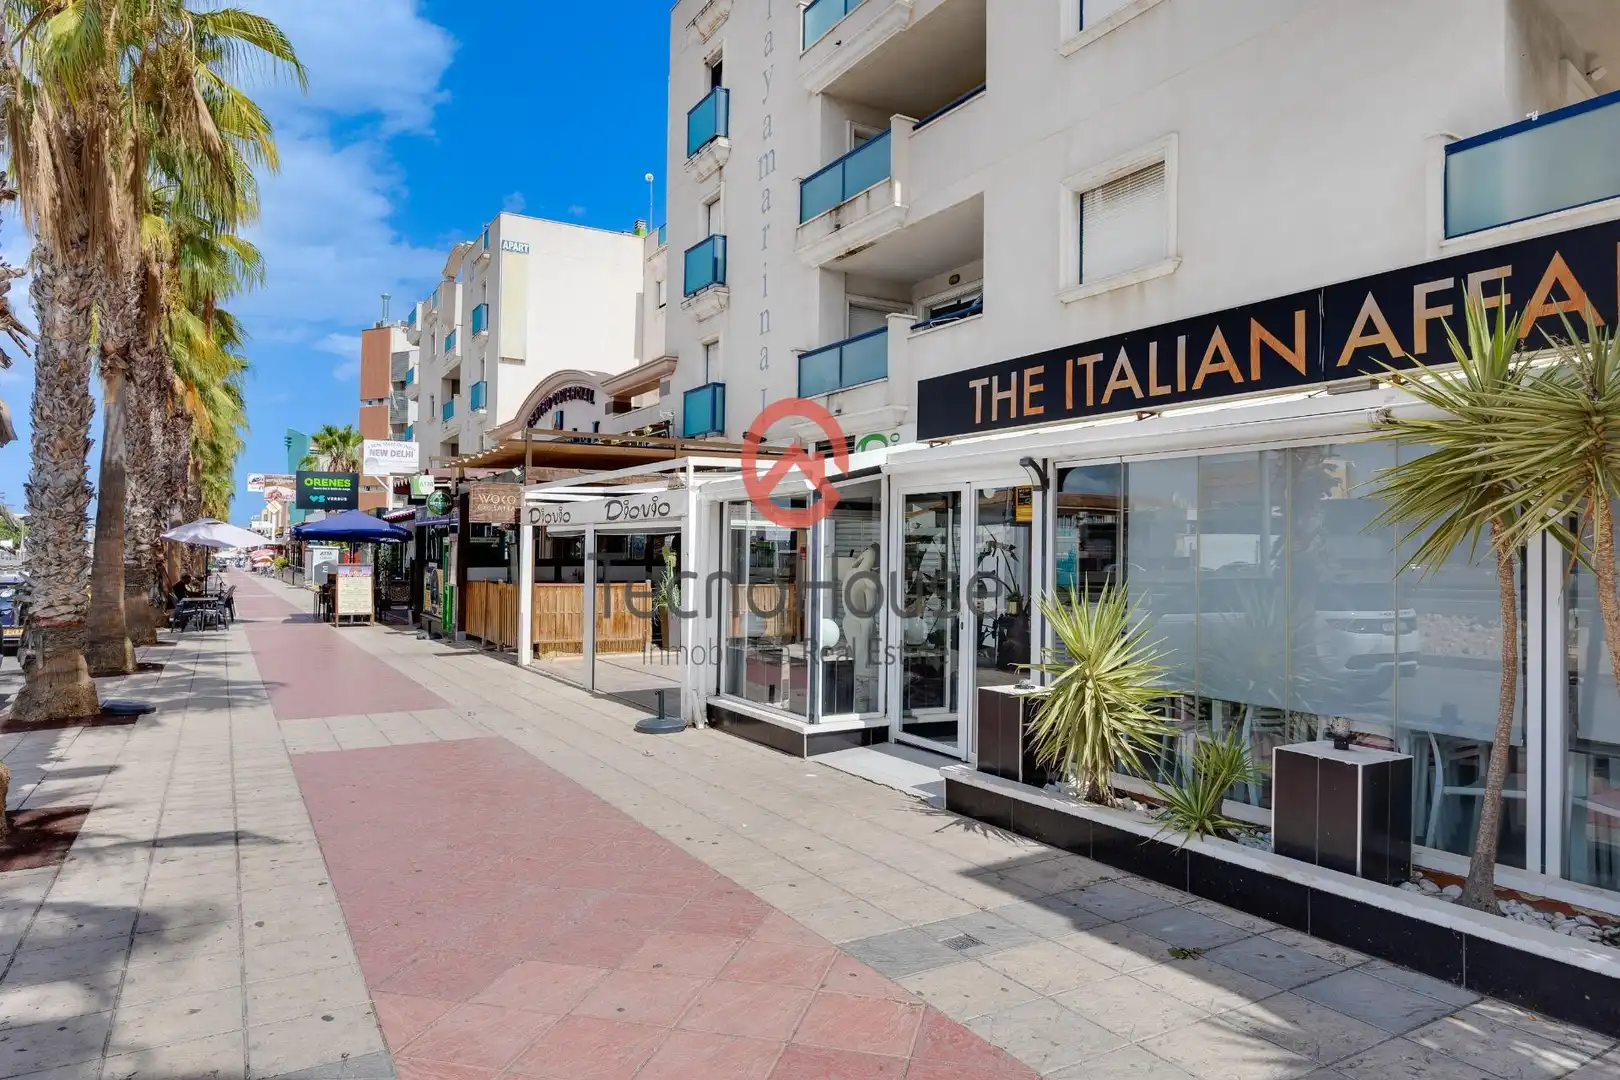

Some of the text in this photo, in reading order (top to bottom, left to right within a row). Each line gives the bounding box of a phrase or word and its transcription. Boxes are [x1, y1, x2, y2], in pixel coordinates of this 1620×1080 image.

[502, 240, 529, 253] APART
[968, 365, 1045, 424] THE
[1065, 309, 1307, 410] ITALIAN
[369, 449, 414, 458] NEW DELHI
[303, 477, 351, 488] ORENES
[528, 506, 571, 525] Diovio
[605, 495, 671, 521] Diovio
